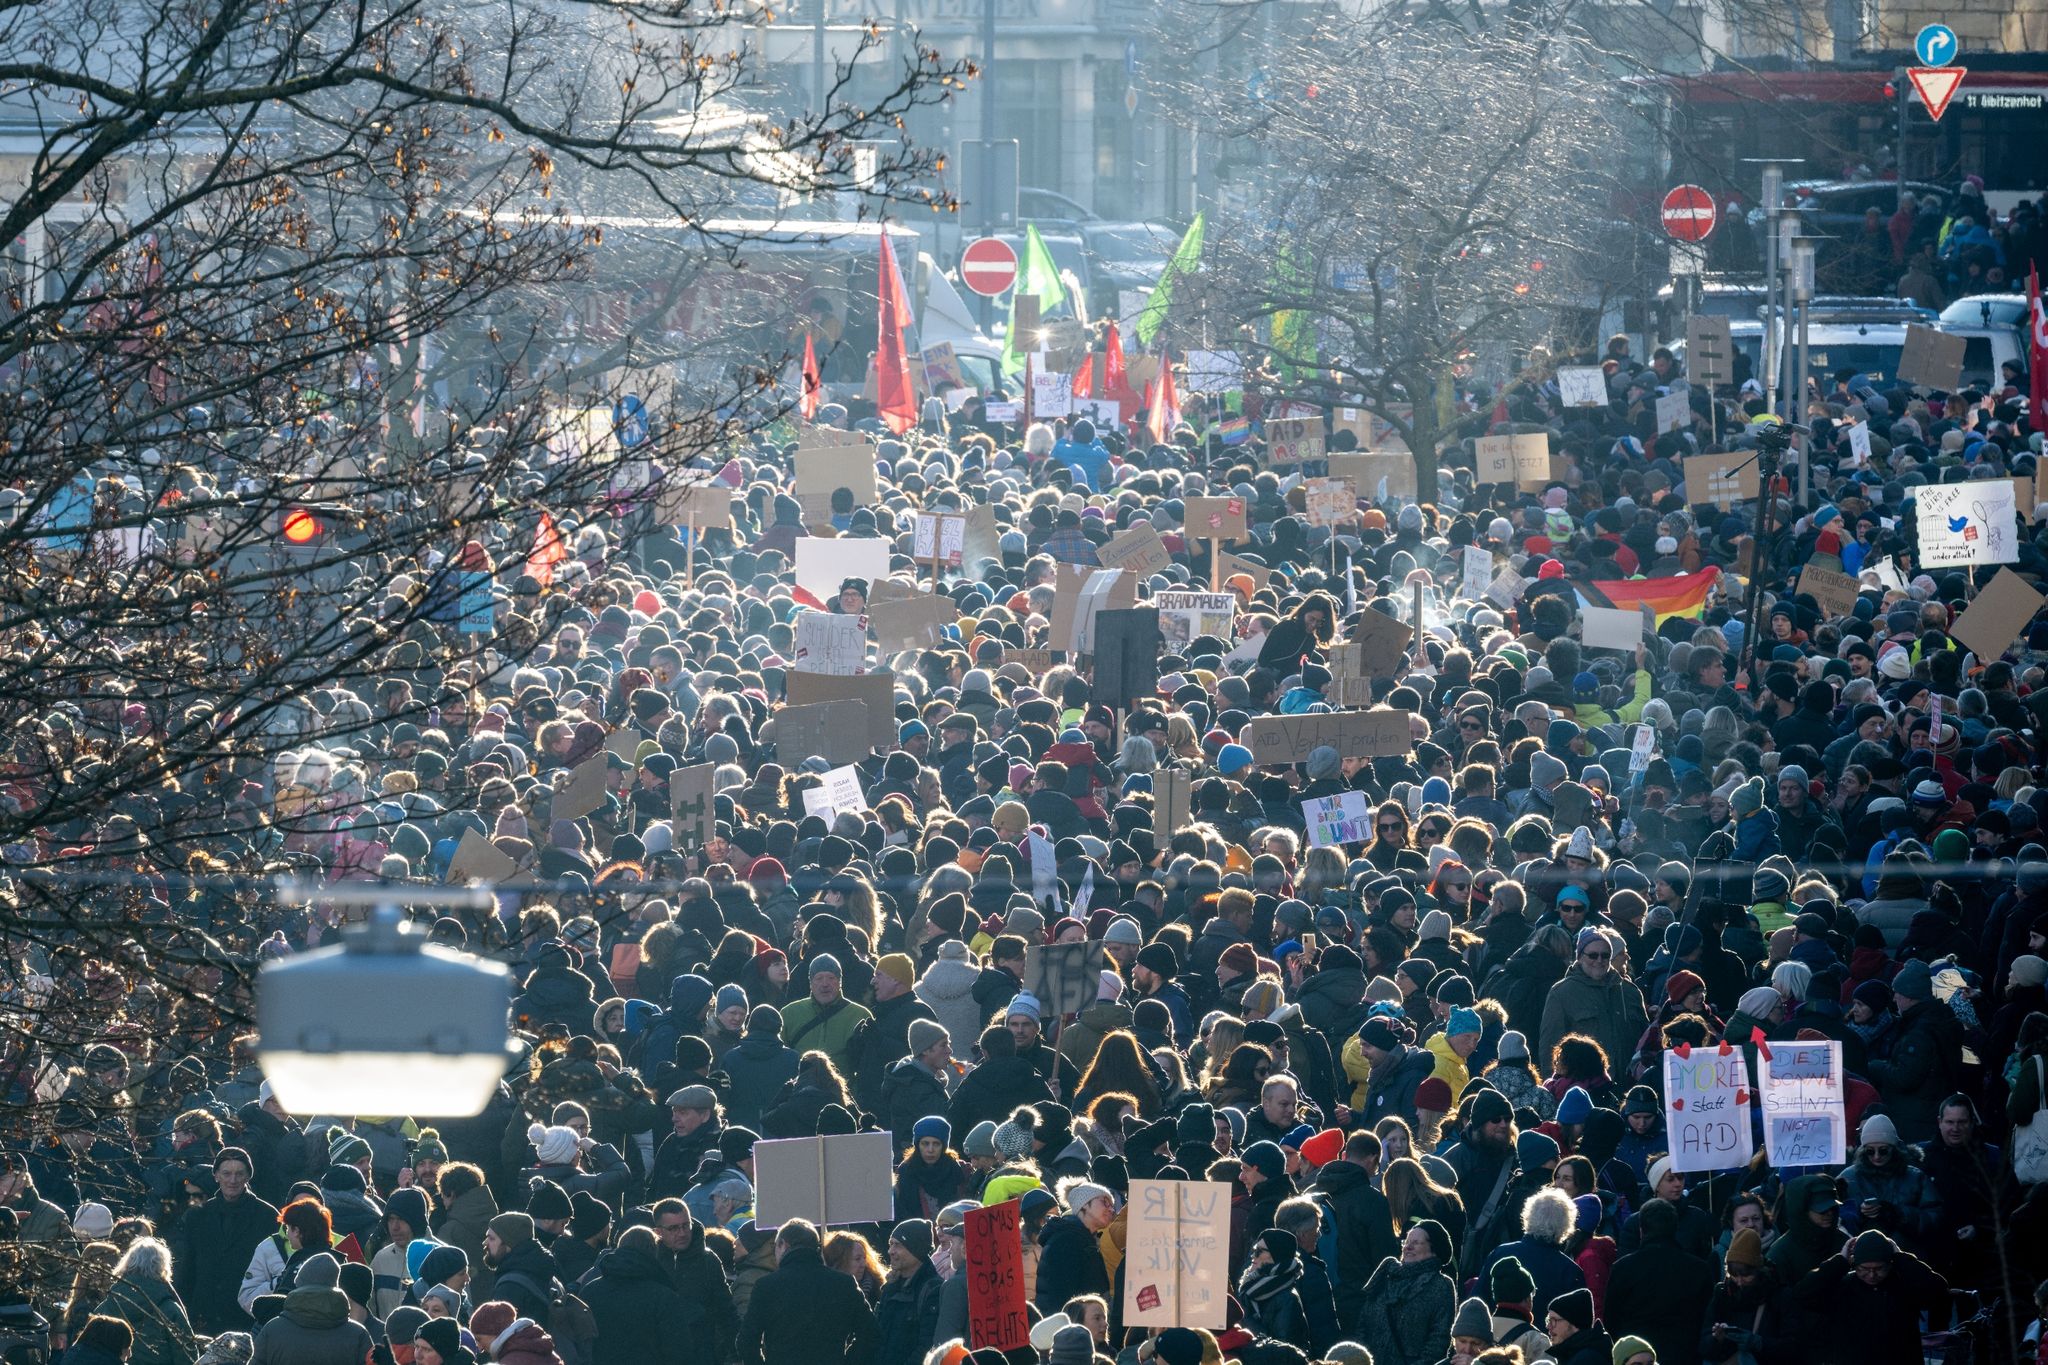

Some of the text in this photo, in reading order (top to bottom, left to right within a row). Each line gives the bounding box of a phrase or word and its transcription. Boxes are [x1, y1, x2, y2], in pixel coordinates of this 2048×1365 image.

[1920, 487, 1935, 500] THE
[1925, 492, 1943, 511] BIRD
[1944, 487, 1961, 507] FREE
[1933, 552, 1951, 561] under
[1160, 593, 1229, 610] BRANDMAUER
[1319, 794, 1343, 811] WIR
[1318, 810, 1346, 824] SIND
[1318, 815, 1368, 844] BUNT
[1772, 1049, 1833, 1068] DIESE
[1670, 1060, 1746, 1092] AMORE
[1769, 1072, 1838, 1090] SONNE
[1691, 1096, 1727, 1113] statt
[1767, 1093, 1834, 1112] SCHEINT
[1683, 1122, 1738, 1154] AfD
[976, 1209, 1014, 1237] OMAS
[976, 1268, 1015, 1295] OPAS
[972, 1310, 1029, 1349] RECHTS
